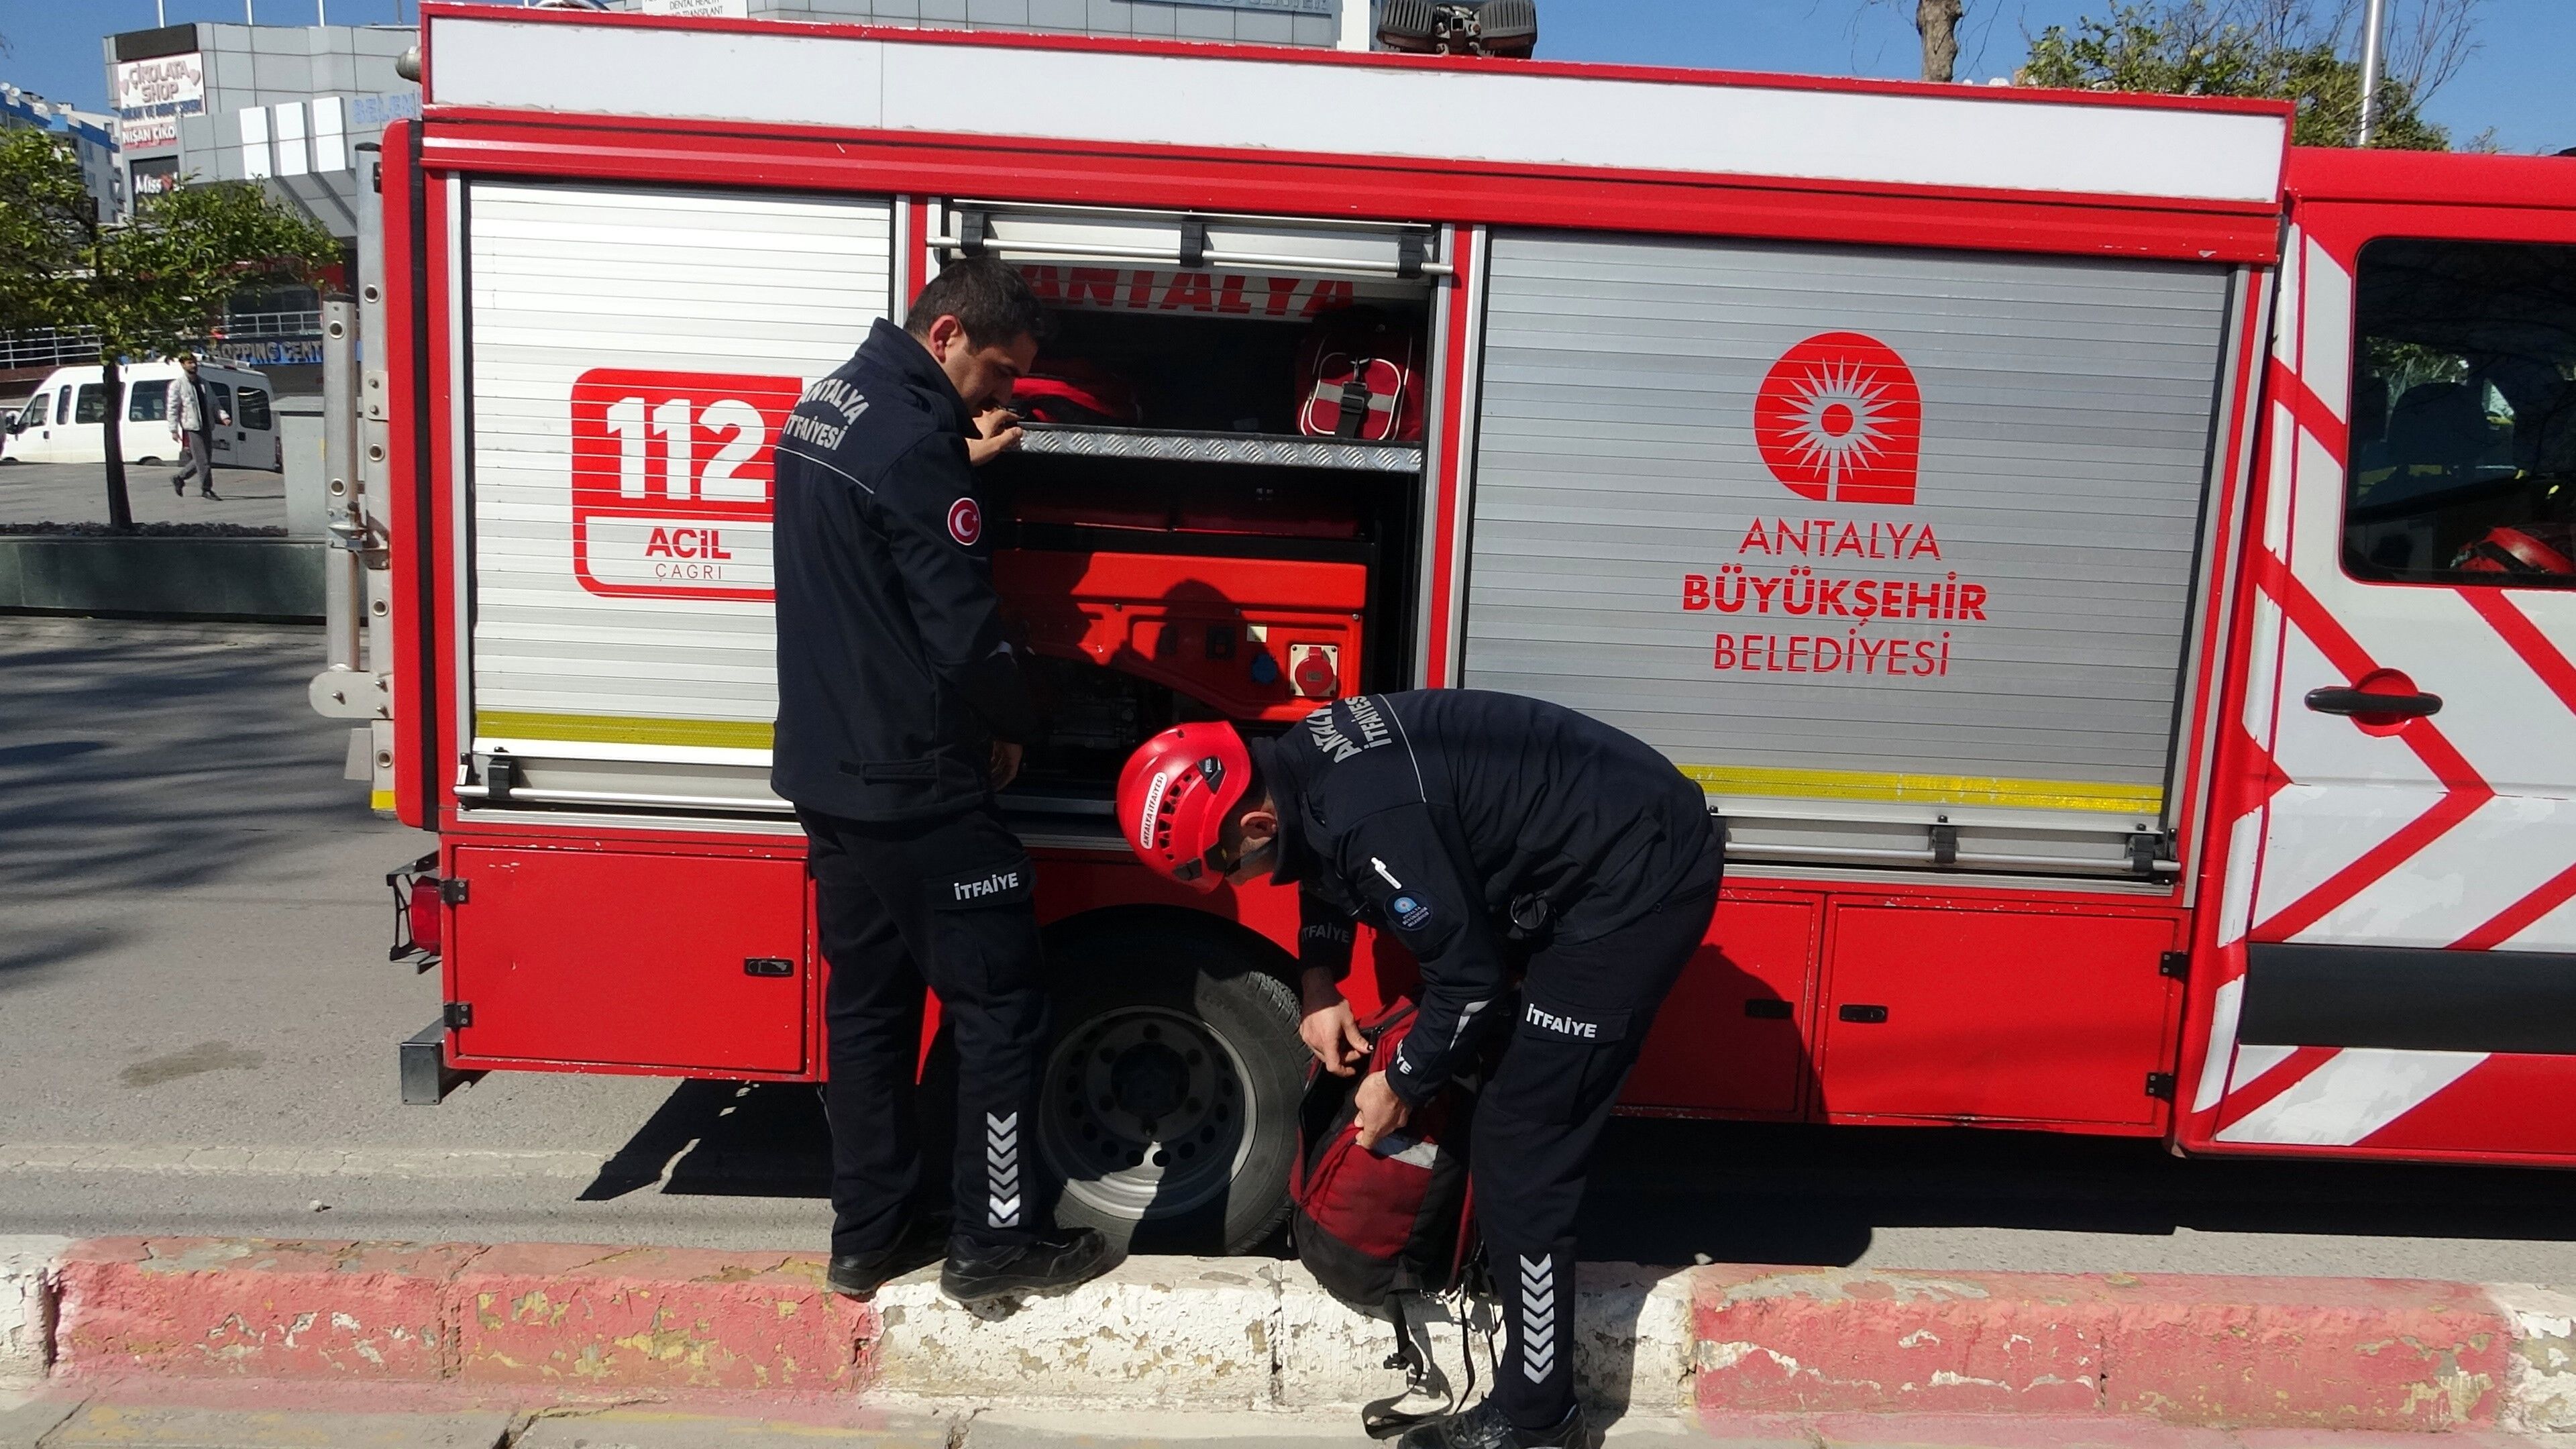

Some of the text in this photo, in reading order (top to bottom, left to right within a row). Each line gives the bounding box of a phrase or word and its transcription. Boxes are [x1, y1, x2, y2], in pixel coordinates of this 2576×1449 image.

[142, 81, 179, 103] SHOP
[1020, 264, 1354, 317] ANTALYA
[606, 397, 766, 502] 112
[645, 527, 732, 560] ACİL
[1739, 517, 1941, 561] ANTALYA
[1682, 563, 1988, 626] BÜYÜKŞEHİR
[1714, 628, 1951, 676] BELEDİYESİ
[1306, 701, 1362, 763] ANTALY
[1143, 812, 1153, 846] ANTALYA
[953, 872, 1019, 900] İTFAİYE
[1526, 1003, 1597, 1038] İTFAİYE
